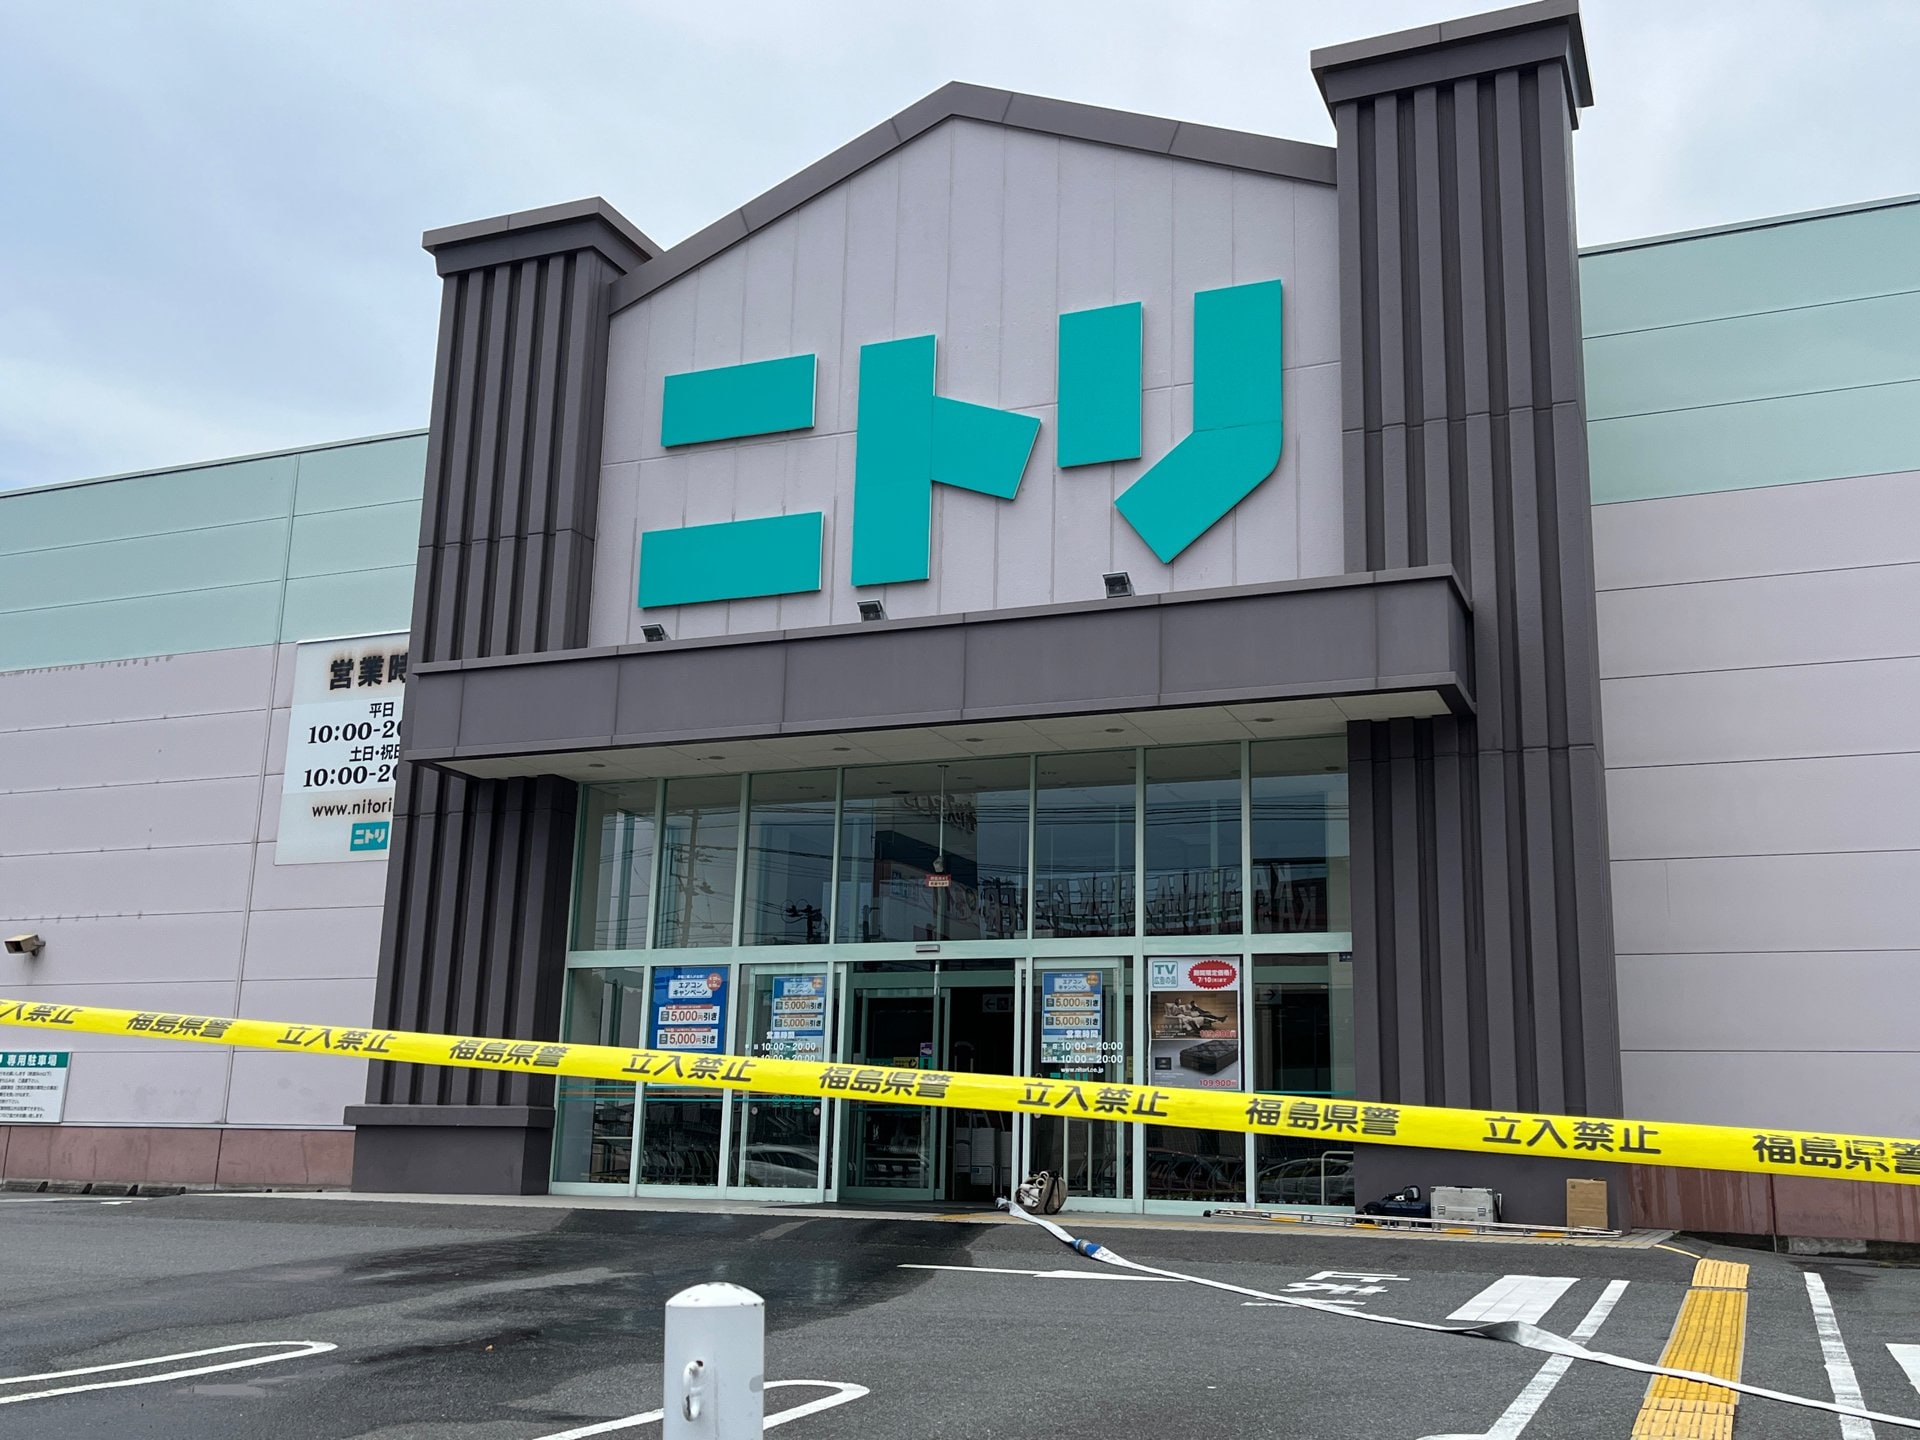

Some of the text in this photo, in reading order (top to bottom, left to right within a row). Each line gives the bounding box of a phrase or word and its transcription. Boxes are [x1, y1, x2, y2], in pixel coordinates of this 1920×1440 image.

[638, 280, 1283, 608] ニトリ
[369, 702, 394, 719] 平日
[353, 828, 386, 845] ニトリ
[1154, 964, 1176, 975] TV
[678, 981, 703, 989] エアコン
[0, 1002, 84, 1024] 入禁止
[126, 1013, 236, 1038] 福島県警
[671, 1010, 718, 1022] 5,000円引き
[276, 1026, 397, 1053] 立入禁止
[669, 1033, 716, 1045] 5,000円引き
[1066, 1030, 1099, 1039] 営業時間
[449, 1039, 570, 1068] 福島県警
[621, 1052, 757, 1082] 立入禁止
[819, 1066, 954, 1099] 福島県警
[1017, 1081, 1169, 1117] 立入禁止
[1245, 1097, 1402, 1137] 福島県警
[1482, 1115, 1662, 1155] 立入禁止
[1752, 1134, 1920, 1174] 福島県警
